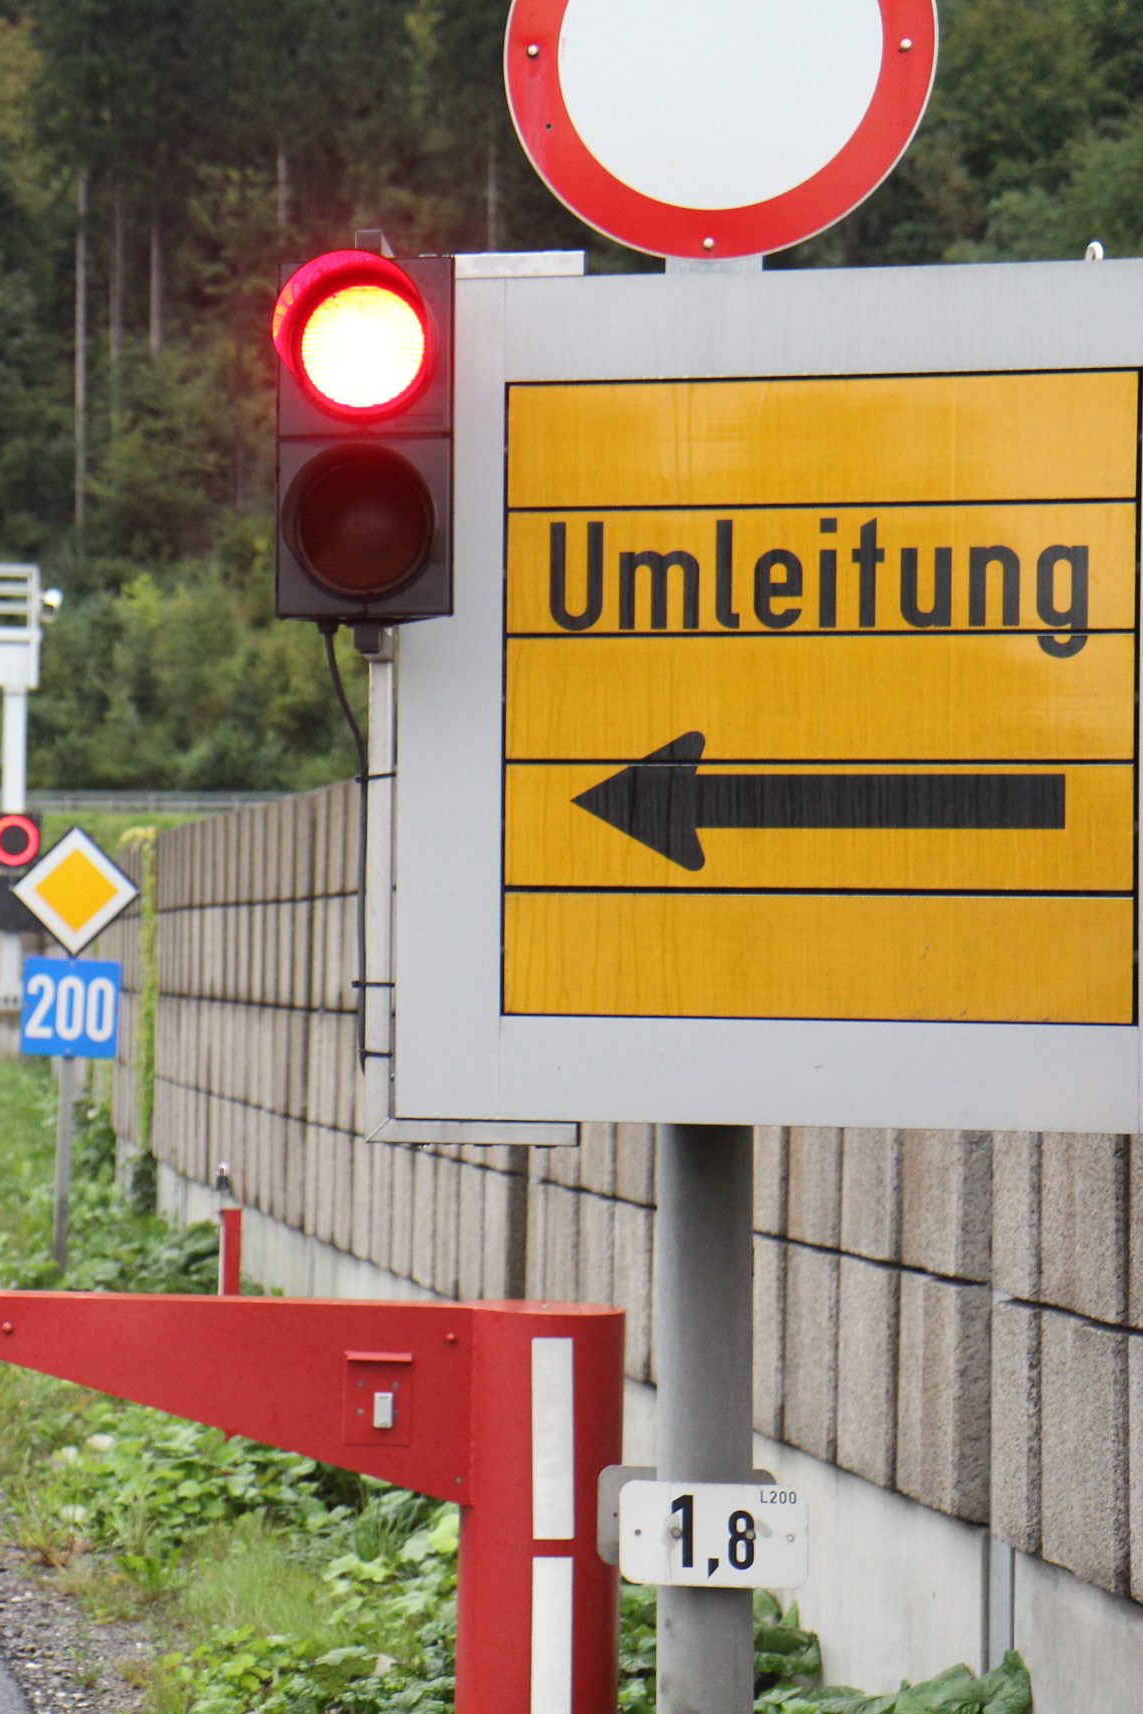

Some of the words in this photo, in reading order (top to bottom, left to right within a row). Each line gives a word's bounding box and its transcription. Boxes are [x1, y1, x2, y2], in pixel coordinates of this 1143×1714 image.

[549, 518, 1089, 658] Umleitung
[25, 974, 115, 1042] 200
[760, 1490, 797, 1504] L200
[671, 1494, 755, 1578] 1,8
